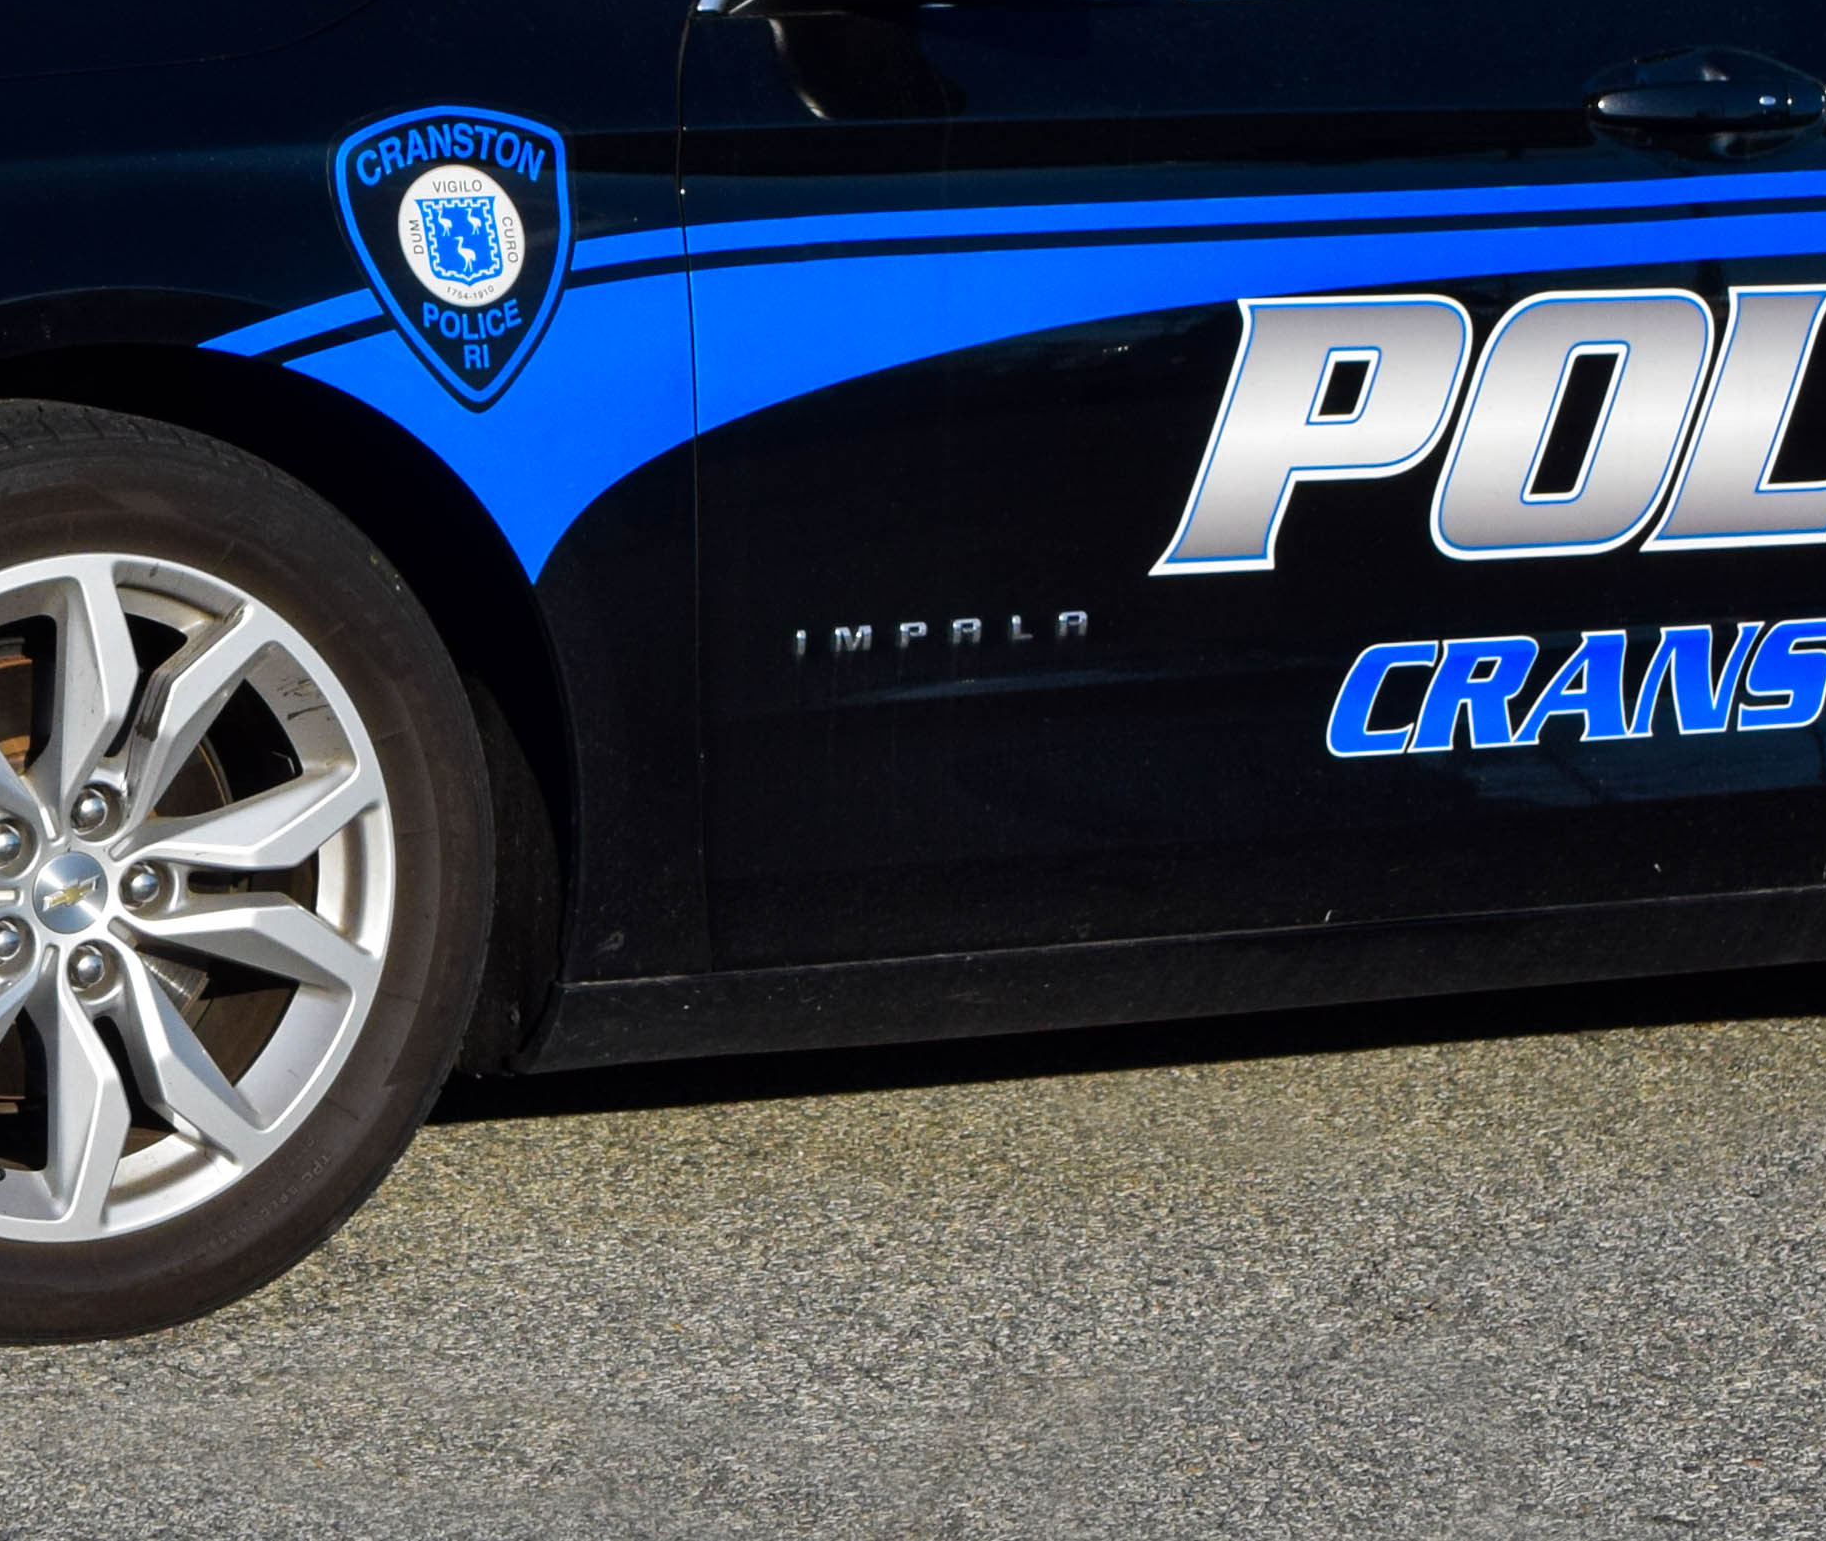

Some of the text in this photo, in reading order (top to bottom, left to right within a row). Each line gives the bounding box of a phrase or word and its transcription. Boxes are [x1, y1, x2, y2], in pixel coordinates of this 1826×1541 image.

[356, 123, 545, 186] CRANSTON
[409, 179, 519, 264] DUM VIGILO CURO
[446, 284, 495, 301] 1754-1910
[423, 298, 522, 339] POLICE
[463, 345, 490, 369] RI
[795, 610, 1088, 656] IMPALA
